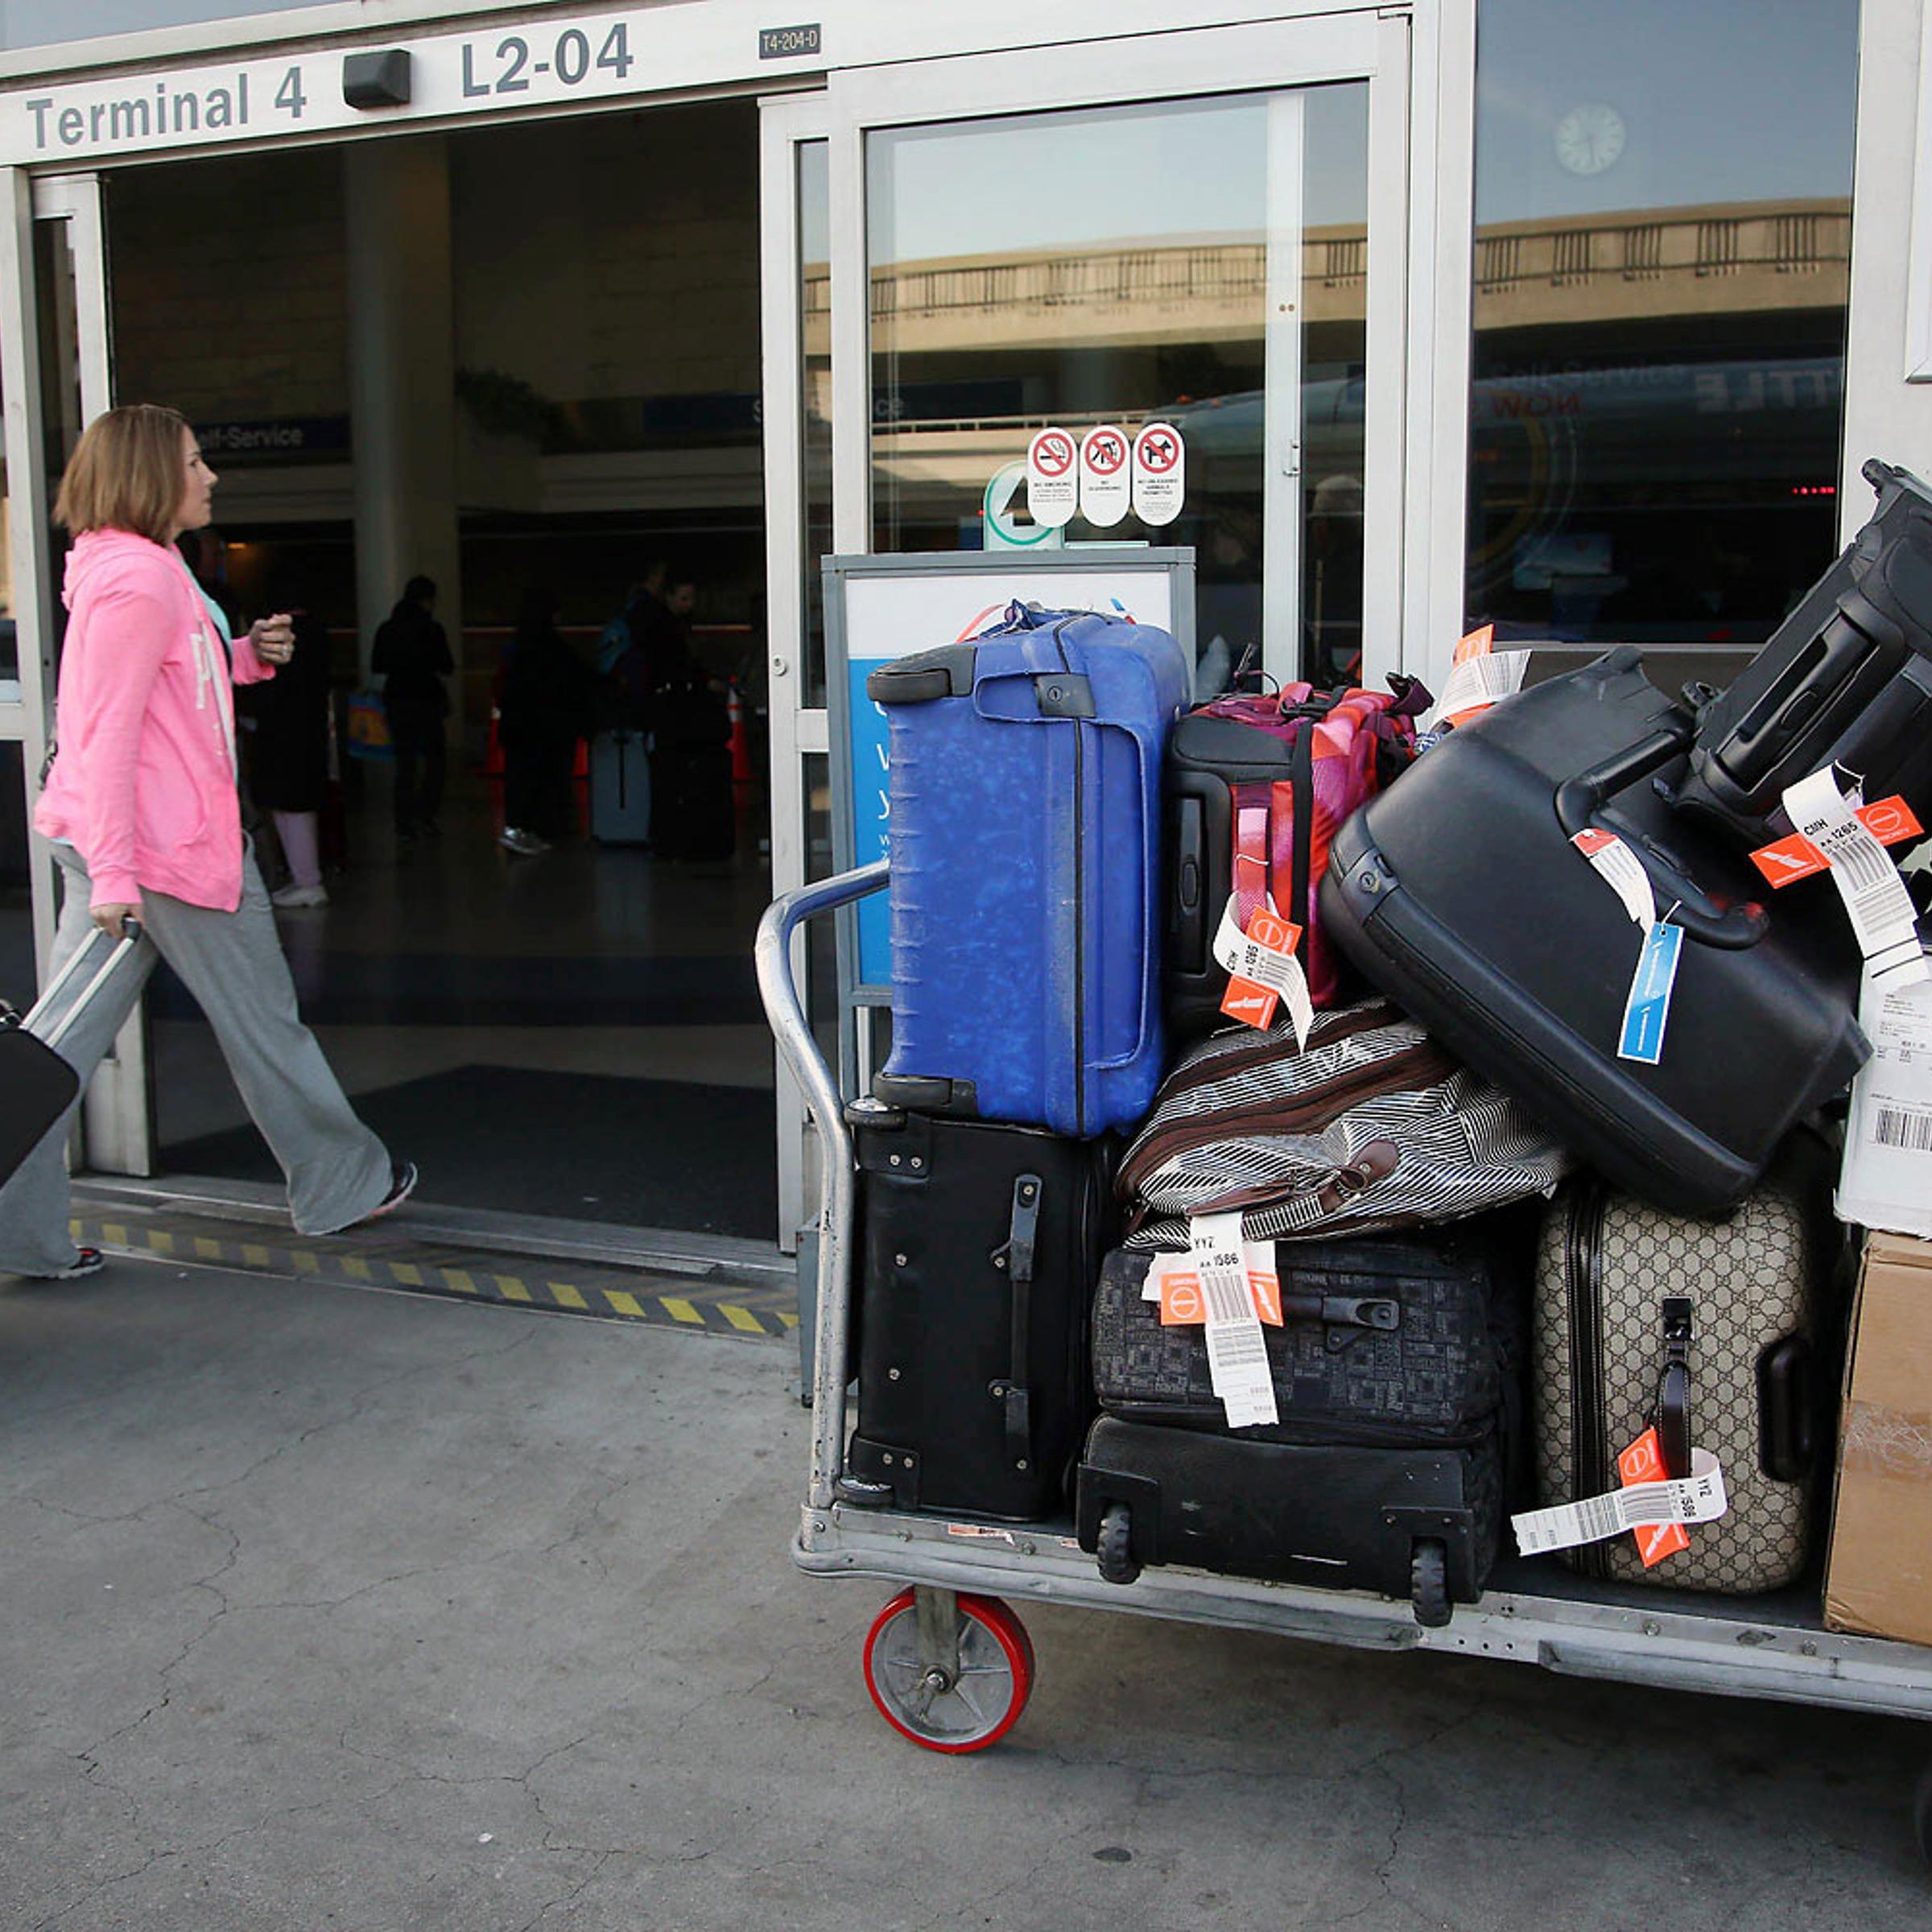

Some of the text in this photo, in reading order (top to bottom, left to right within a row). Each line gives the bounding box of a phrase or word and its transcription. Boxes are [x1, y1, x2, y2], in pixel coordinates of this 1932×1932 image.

[462, 23, 634, 97] L2-04
[27, 66, 308, 149] Terminal 4
[198, 425, 304, 449] elf-Service
